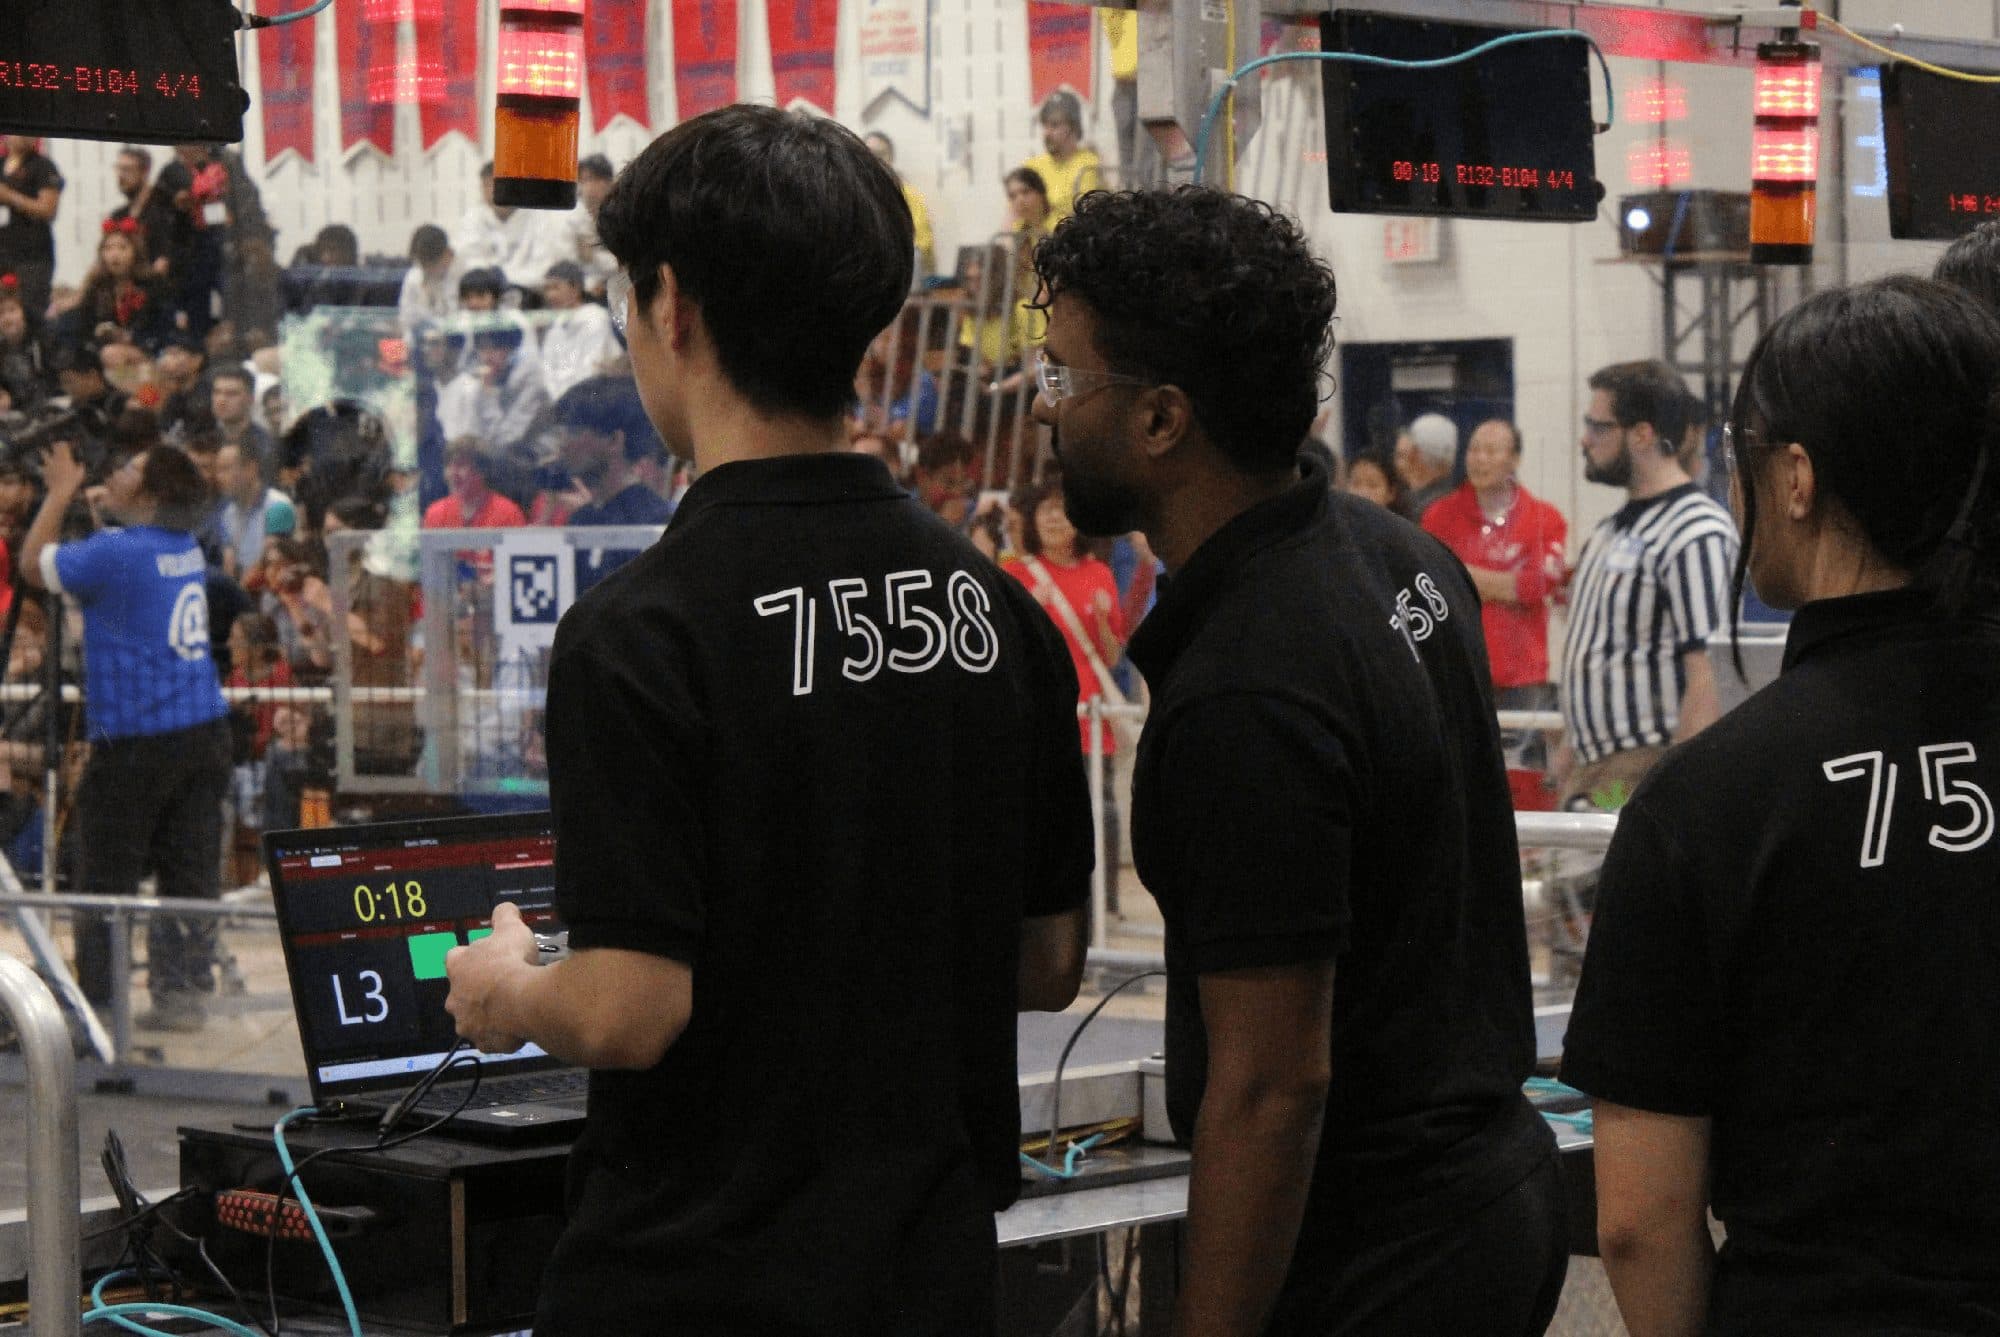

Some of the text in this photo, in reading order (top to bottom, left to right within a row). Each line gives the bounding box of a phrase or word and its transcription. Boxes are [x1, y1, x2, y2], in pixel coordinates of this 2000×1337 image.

[0, 61, 201, 98] R132-B104 4/4
[1392, 160, 1574, 191] 00:18 R132-B104 4/4
[753, 569, 999, 696] 7558
[1822, 741, 1995, 868] 75
[353, 880, 427, 922] 0:18
[332, 969, 389, 1025] L3
